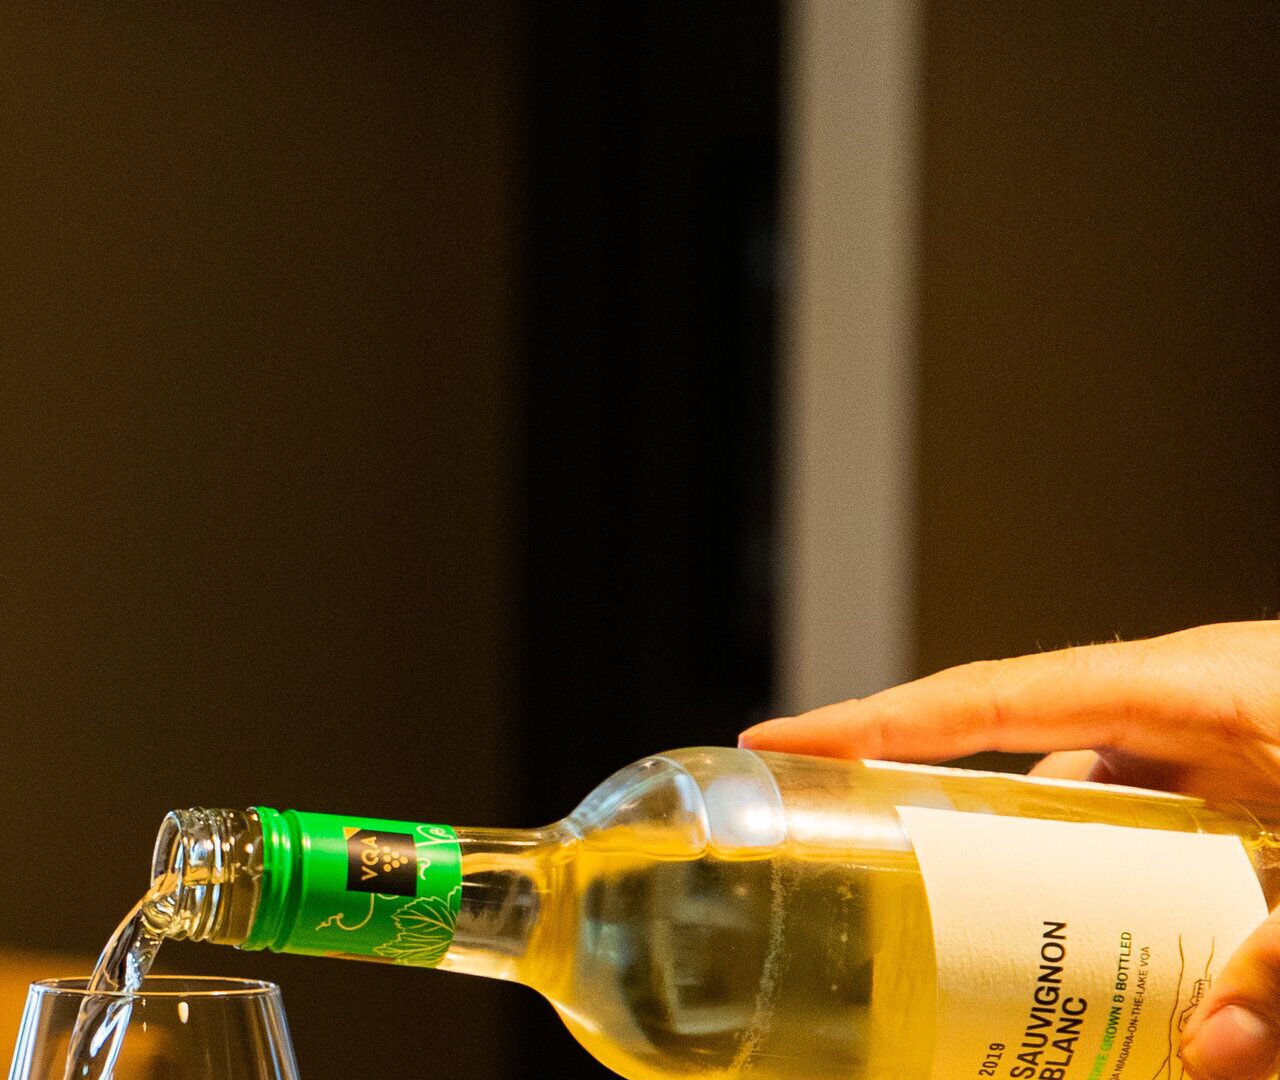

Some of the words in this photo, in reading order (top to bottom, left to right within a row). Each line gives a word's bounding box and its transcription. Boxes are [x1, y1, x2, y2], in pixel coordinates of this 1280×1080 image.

[361, 836, 380, 881] VQA
[1140, 946, 1151, 967] VQA
[1009, 921, 1067, 1080] SAUVIGNON
[1101, 1006, 1122, 1052] GROWN
[1115, 931, 1132, 991] BOTTLED
[978, 1042, 1006, 1077] 2019
